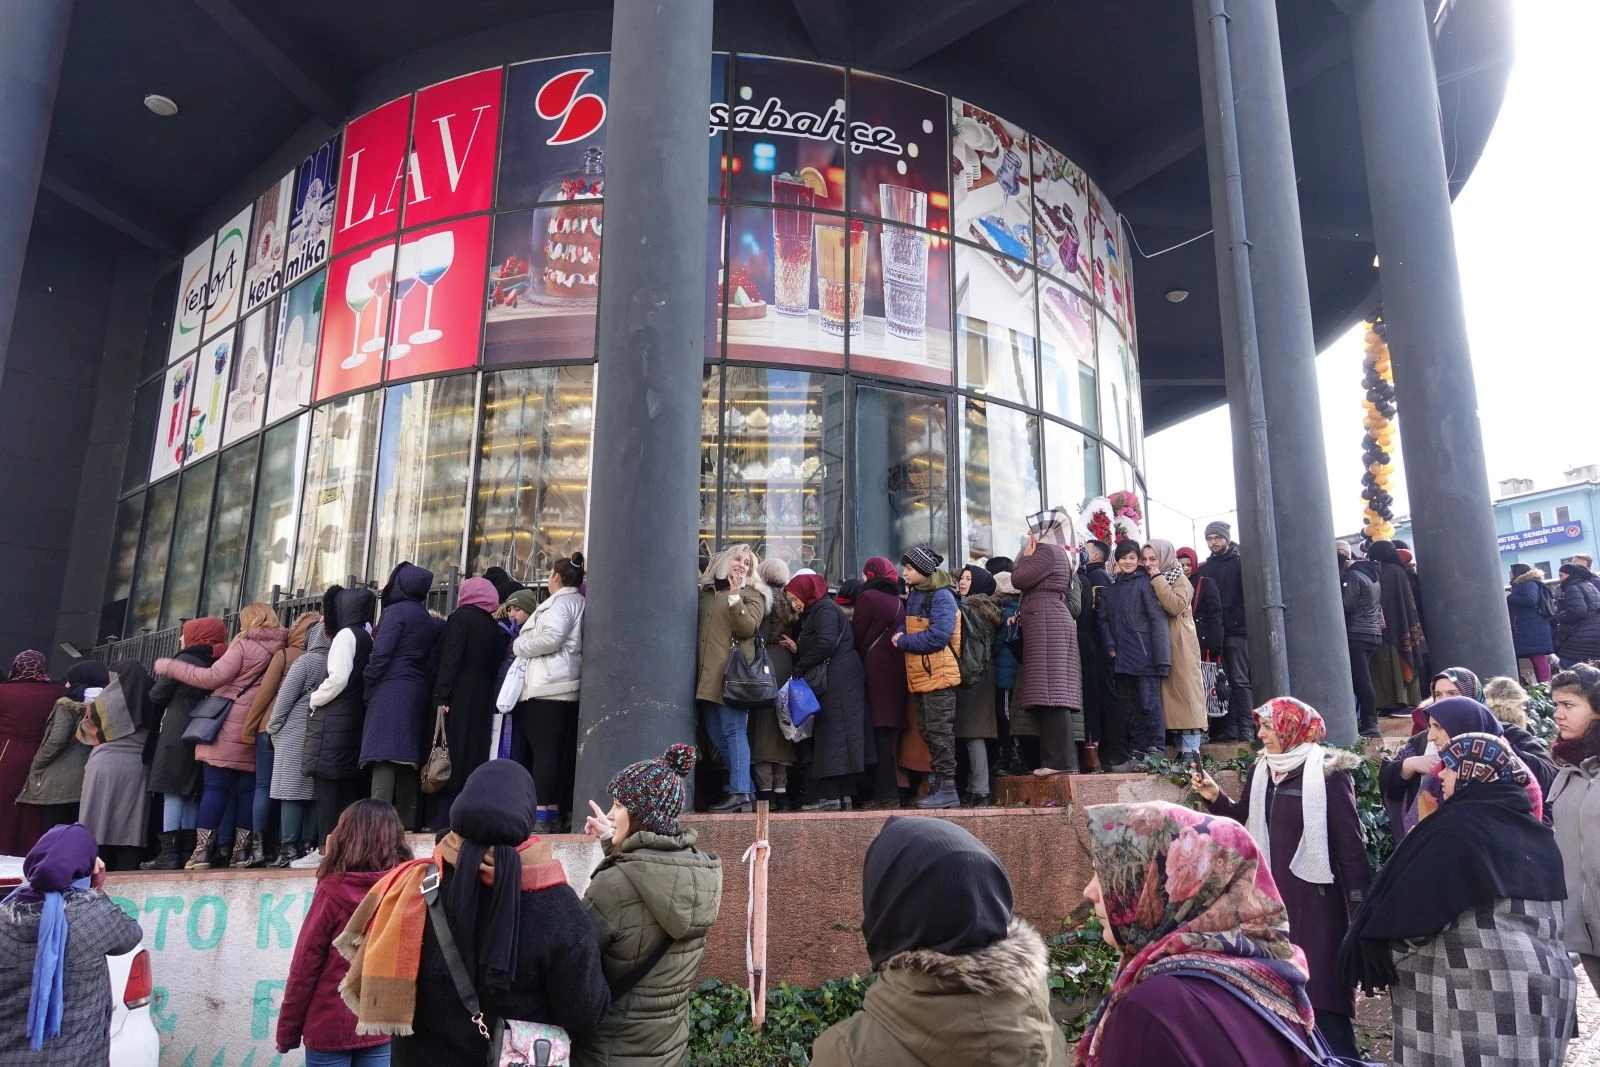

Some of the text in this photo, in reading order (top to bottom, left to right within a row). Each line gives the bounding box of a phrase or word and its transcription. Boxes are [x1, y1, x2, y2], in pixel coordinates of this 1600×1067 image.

[338, 104, 492, 233] LAV
[247, 239, 326, 309] keramika
[1519, 536, 1547, 548] ŞUBESİ
